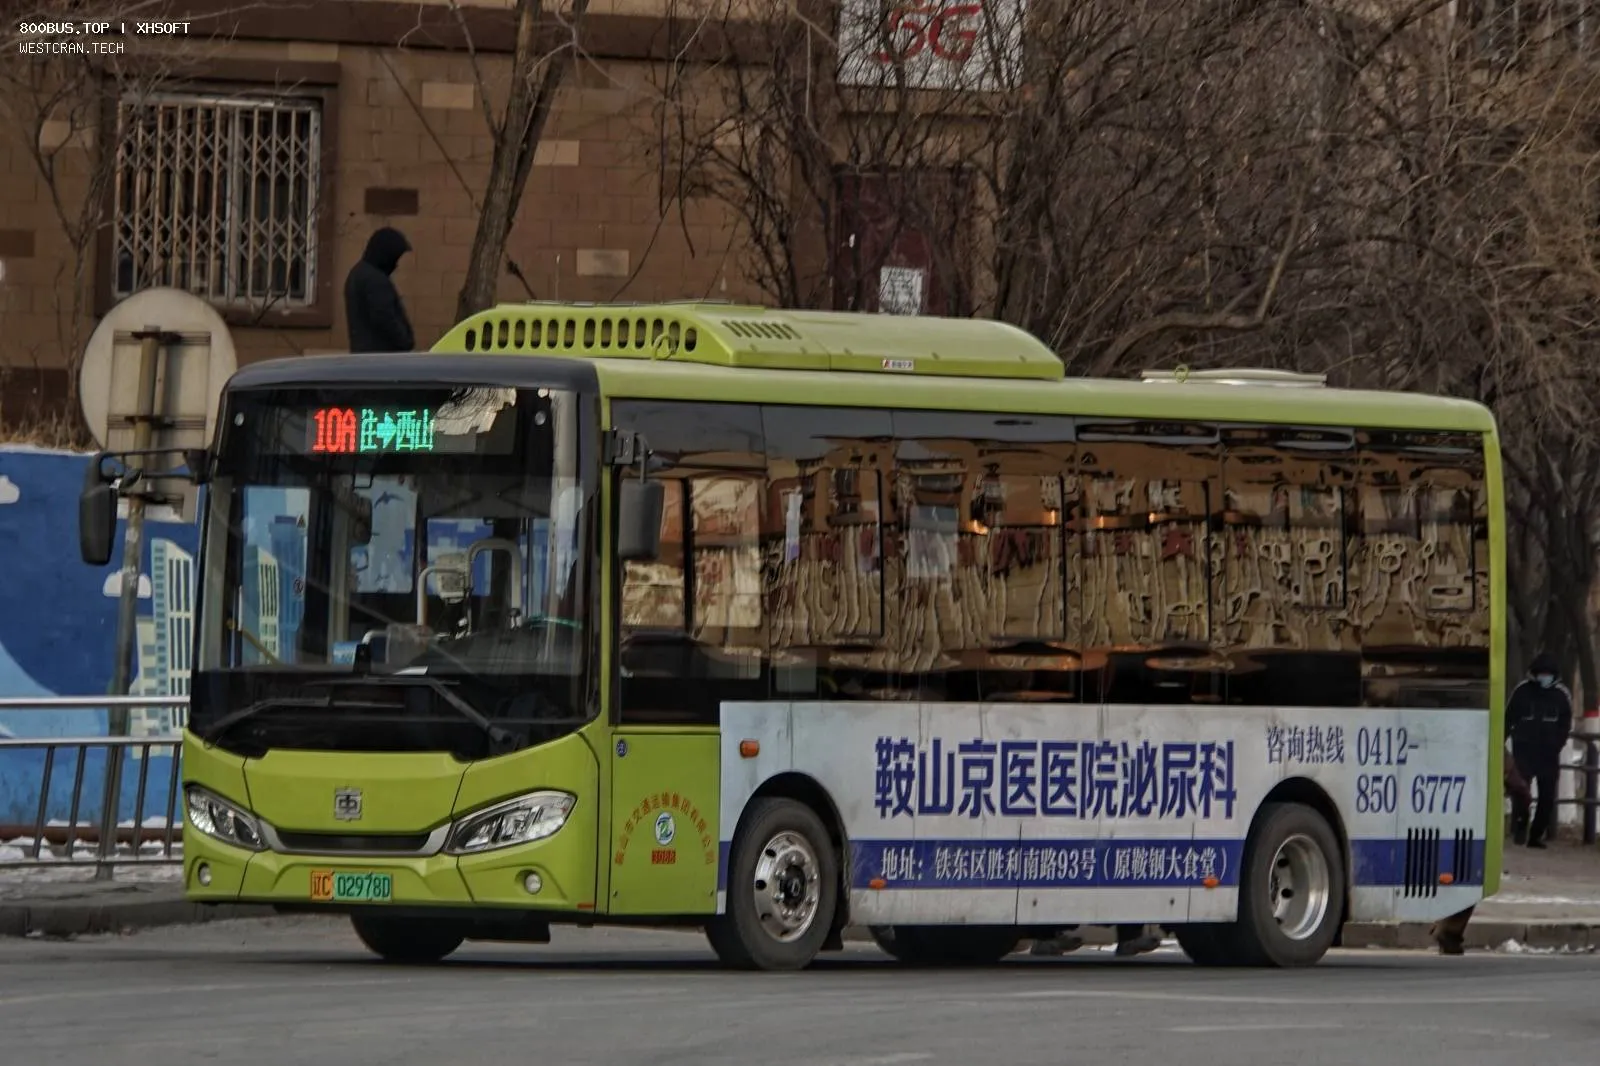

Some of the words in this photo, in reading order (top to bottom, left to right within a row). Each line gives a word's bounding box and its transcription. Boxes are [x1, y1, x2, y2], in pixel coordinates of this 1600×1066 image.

[871, 4, 983, 63] 5G
[312, 408, 357, 453] 10A
[1267, 726, 1345, 764] 咨询热线
[1357, 726, 1419, 765] 0412-
[875, 736, 1237, 820] 鞍山京医医院泌尿科
[1356, 774, 1397, 814] 850
[1412, 775, 1467, 814] 6777
[337, 875, 391, 898] 02978D
